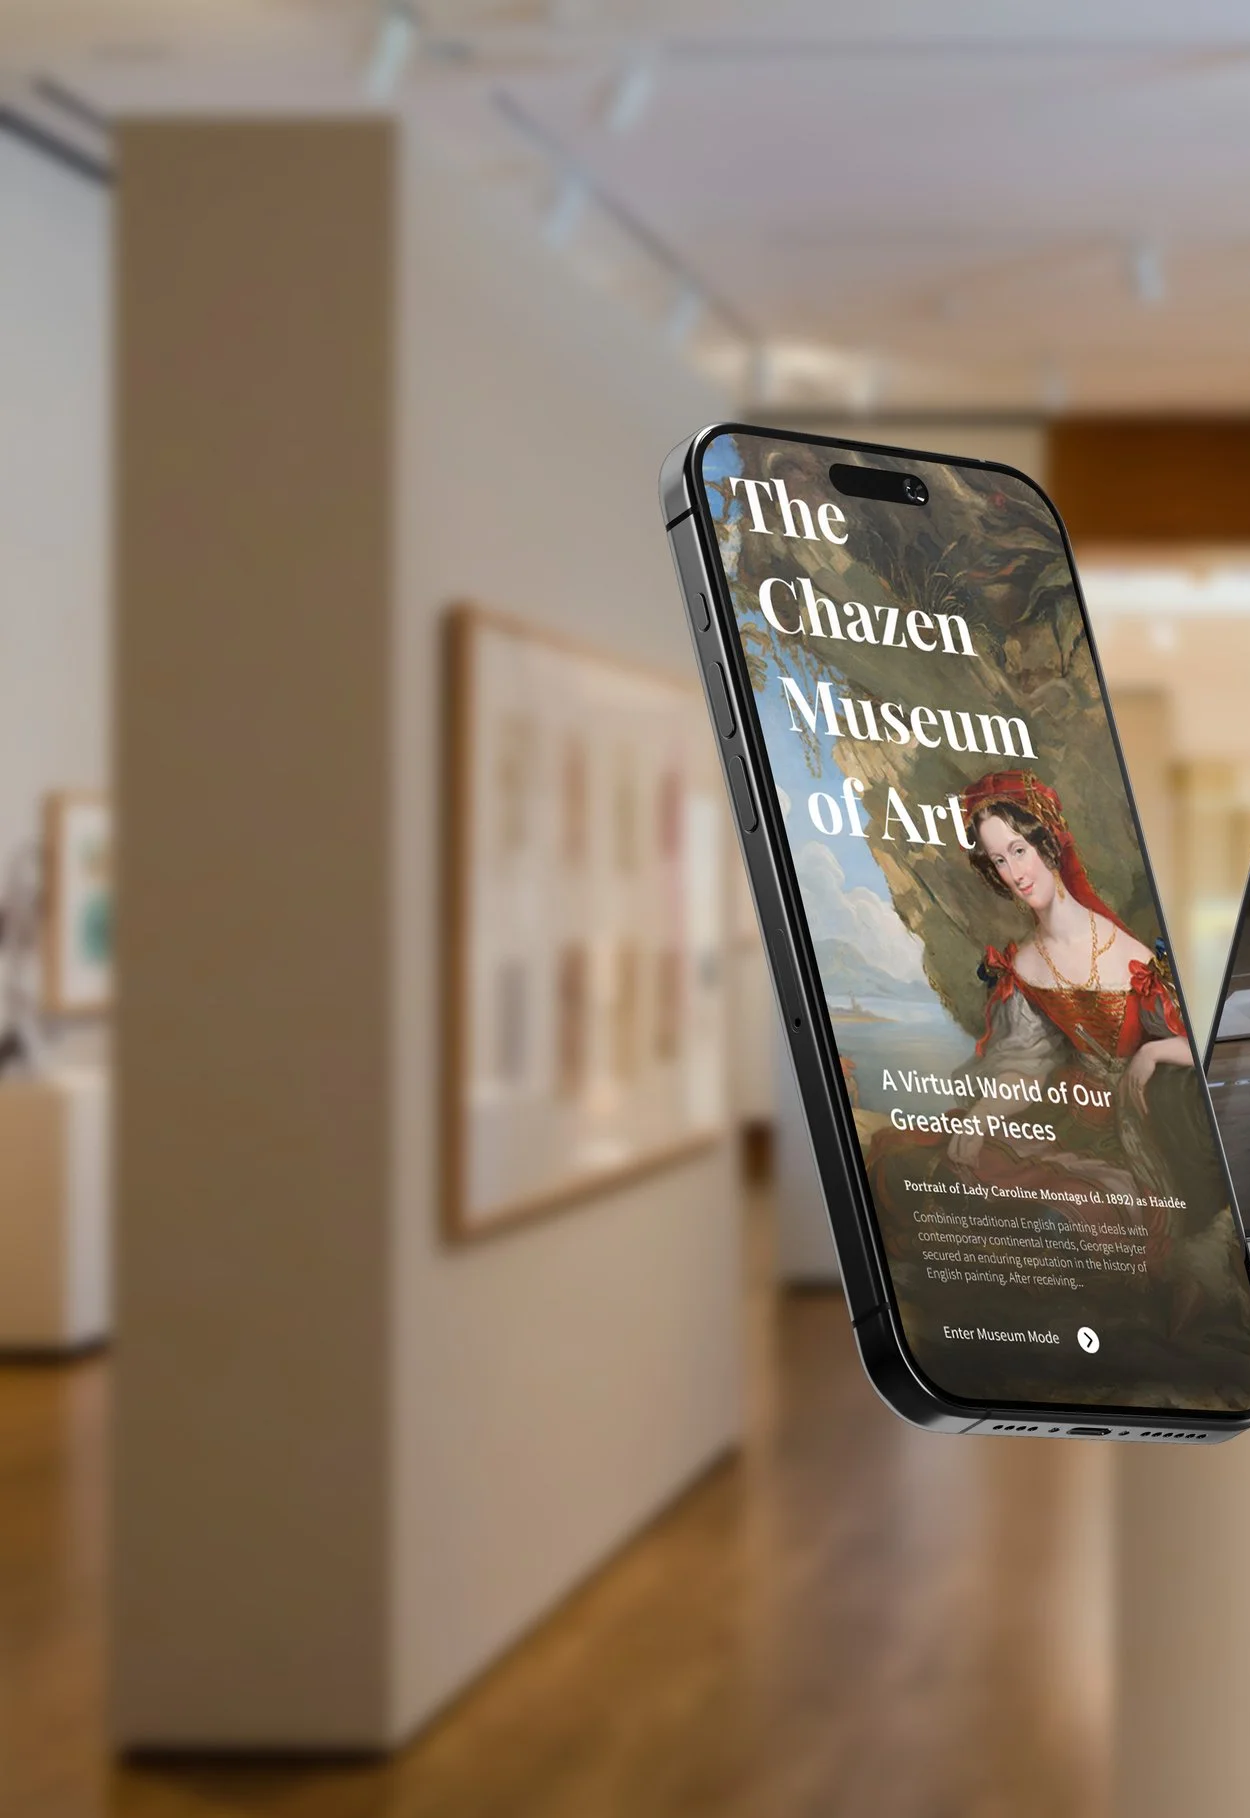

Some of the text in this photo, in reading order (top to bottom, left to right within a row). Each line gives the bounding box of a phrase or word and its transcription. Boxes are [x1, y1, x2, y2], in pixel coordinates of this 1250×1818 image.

[729, 477, 849, 545] The
[758, 577, 978, 657] Chazen
[777, 676, 1038, 759] Museum
[808, 777, 976, 850] of Art
[882, 1069, 1112, 1108] A Virtual World of Our
[890, 1108, 1056, 1141] Greatest Pieces
[904, 1180, 1187, 1209] Portrait of Lady Caroline Montagu (d. 1892) as Haidée
[913, 1211, 1149, 1236] Combining traditional English painting ideals with
[918, 1231, 1146, 1256] contemporary continental trends, George Hayter
[922, 1250, 1147, 1275] secured an enduring reputation in the history of
[927, 1267, 1084, 1290] English painting. After receiving...
[943, 1325, 1060, 1344] Enter Museum Mode
